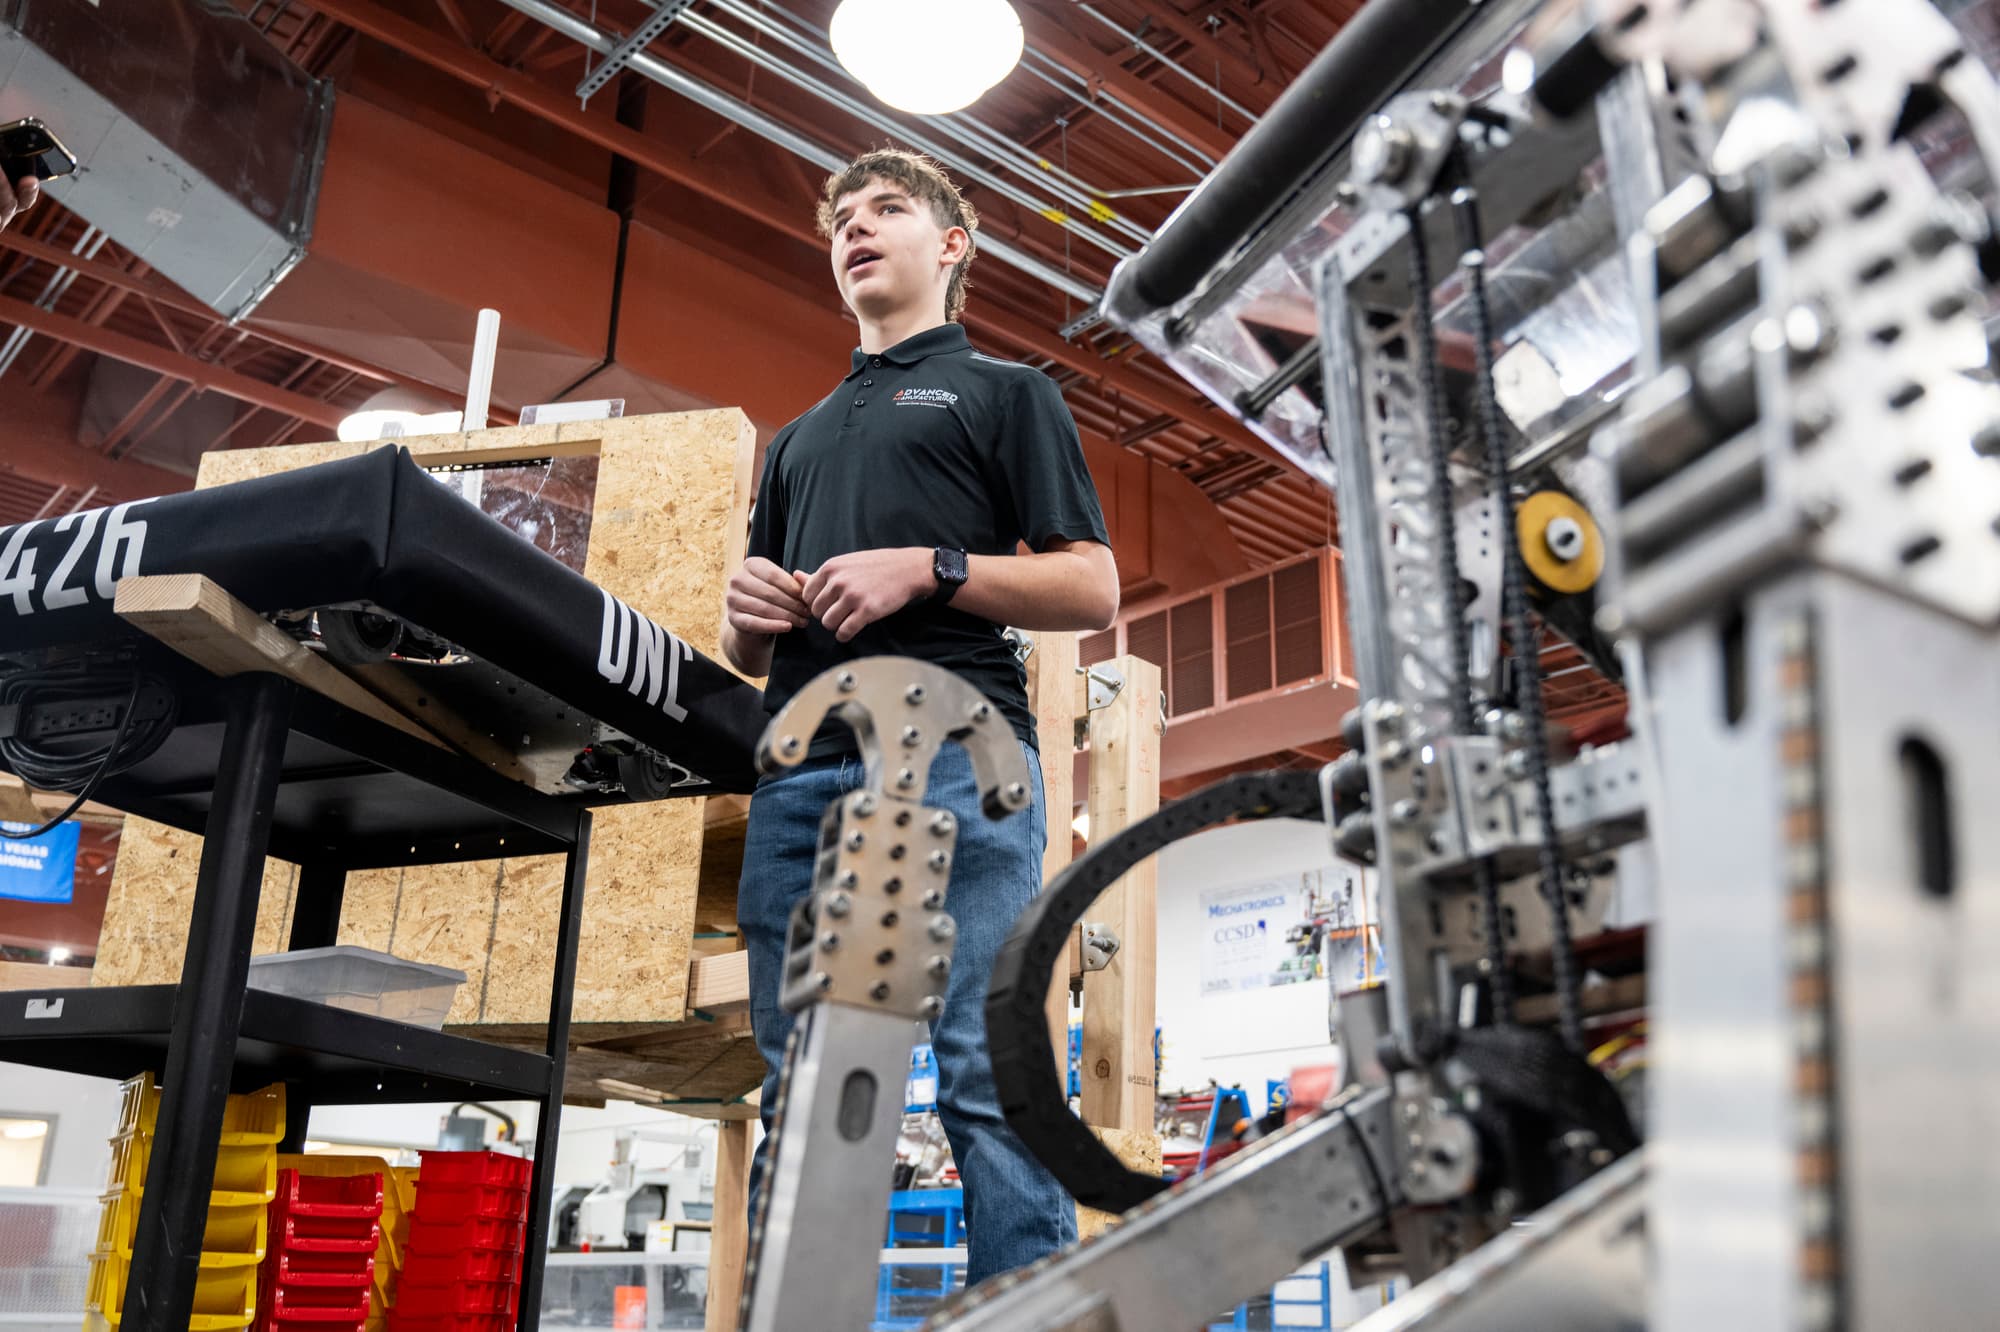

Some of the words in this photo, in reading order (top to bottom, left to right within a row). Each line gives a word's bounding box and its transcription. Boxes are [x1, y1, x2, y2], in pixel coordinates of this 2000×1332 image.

[894, 389, 958, 401] ADVANCED
[0, 496, 162, 616] 426
[5, 842, 49, 858] VEGAS
[1214, 924, 1255, 943] CCSD
